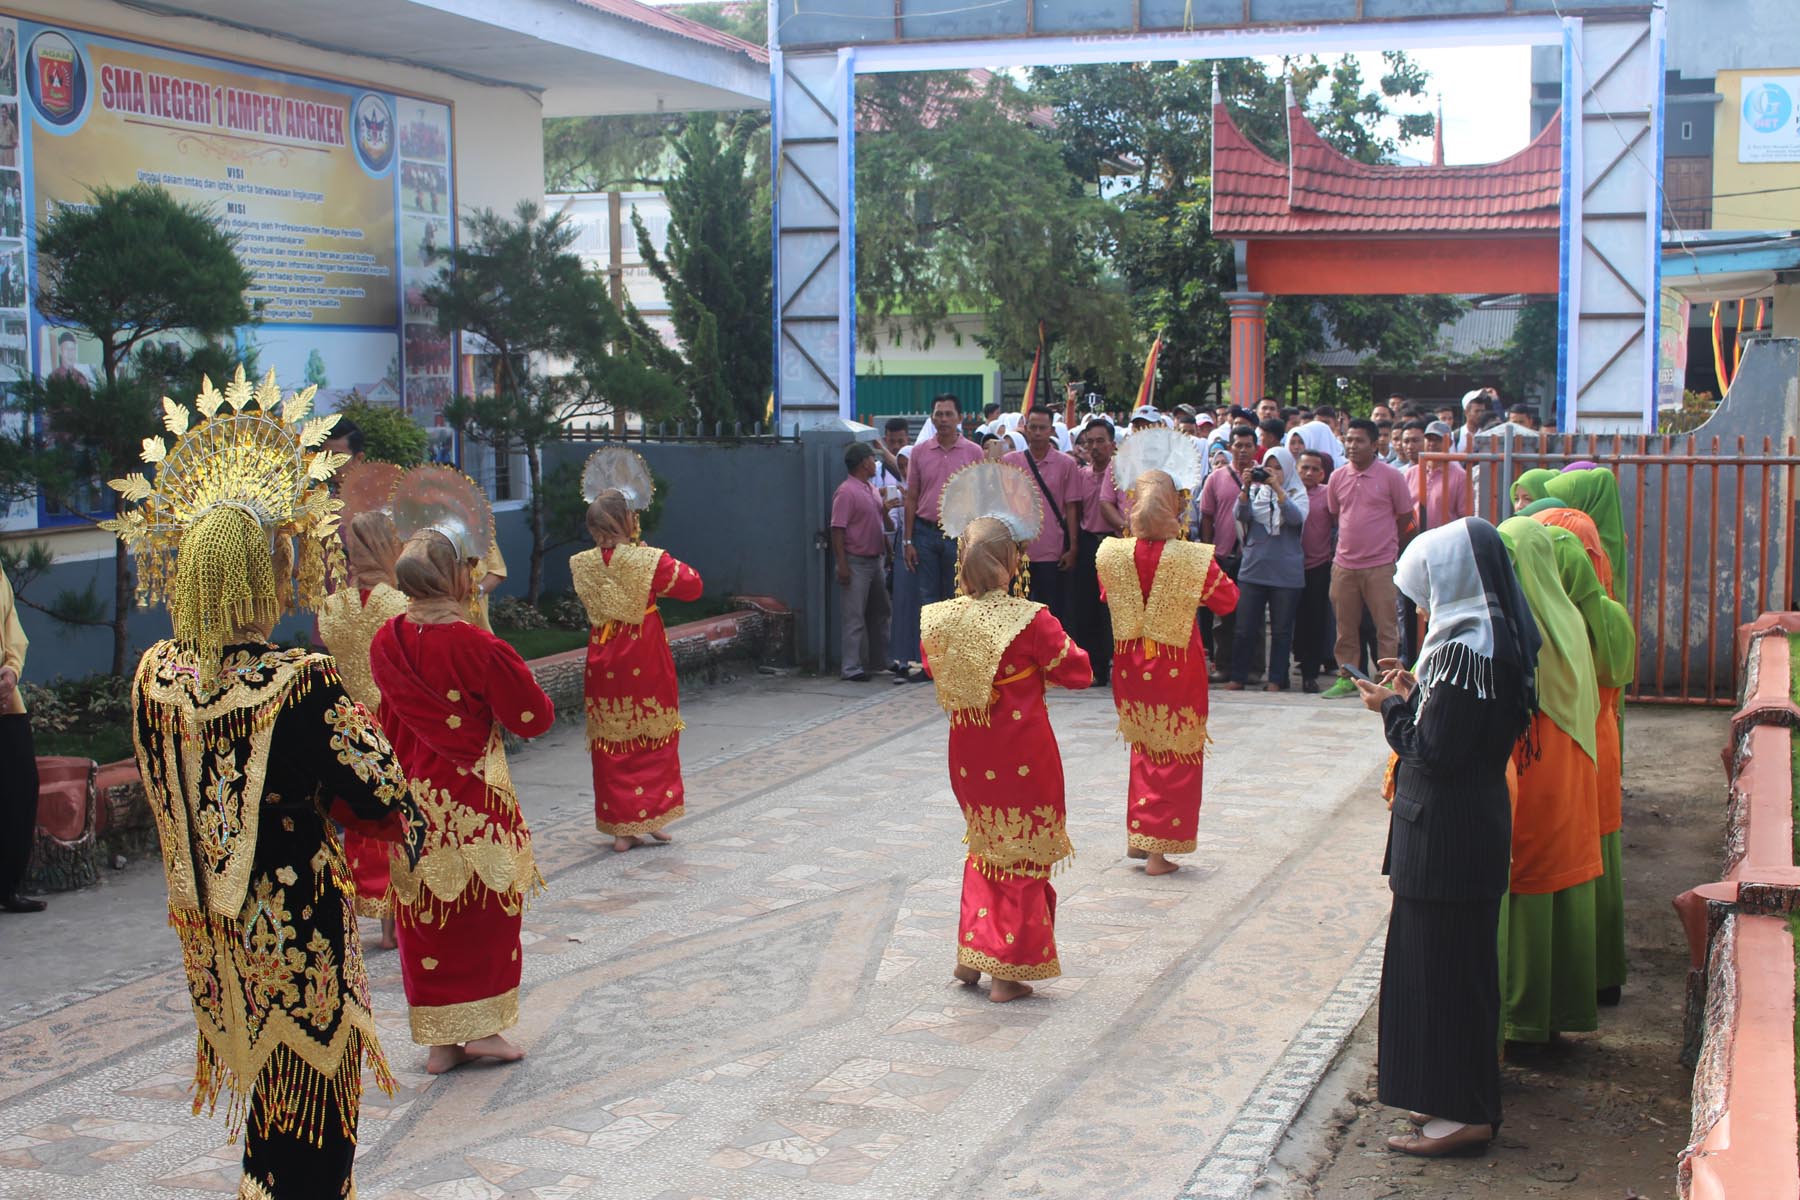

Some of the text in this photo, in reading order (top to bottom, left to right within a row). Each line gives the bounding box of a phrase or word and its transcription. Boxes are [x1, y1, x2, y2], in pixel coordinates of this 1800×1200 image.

[101, 65, 345, 146] SMA NEGERI 1 AMPEK ANGKEK
[226, 167, 244, 180] VISI
[137, 170, 161, 185] Unggul
[162, 174, 183, 184] dalam
[203, 179, 217, 188] dan
[236, 183, 254, 193] serta
[254, 184, 291, 197] berwawasan
[292, 188, 325, 202] lingkungan
[226, 202, 246, 215] MISI
[232, 219, 260, 230] didukung
[261, 222, 274, 230] oleh
[274, 222, 321, 235] Profesionalisme
[321, 226, 340, 237] Tenaga
[243, 233, 305, 245] proses pembelajaran
[249, 246, 274, 255] spiritual
[275, 247, 287, 256] dan
[287, 249, 304, 257] moral
[305, 251, 319, 259] yang
[247, 258, 275, 268] teknologi
[276, 260, 287, 268] dan
[288, 261, 315, 270] informasi
[315, 263, 336, 272] dengan
[266, 271, 293, 281] terhadap
[293, 272, 325, 283] lingkungan
[267, 284, 288, 293] bidang
[288, 286, 316, 294] akademis
[316, 287, 328, 295] dan
[275, 297, 294, 306] Tinggi
[294, 299, 308, 307] yang
[308, 299, 341, 309] berkualitas
[263, 309, 293, 318] lingkungan
[295, 310, 313, 319] hidup
